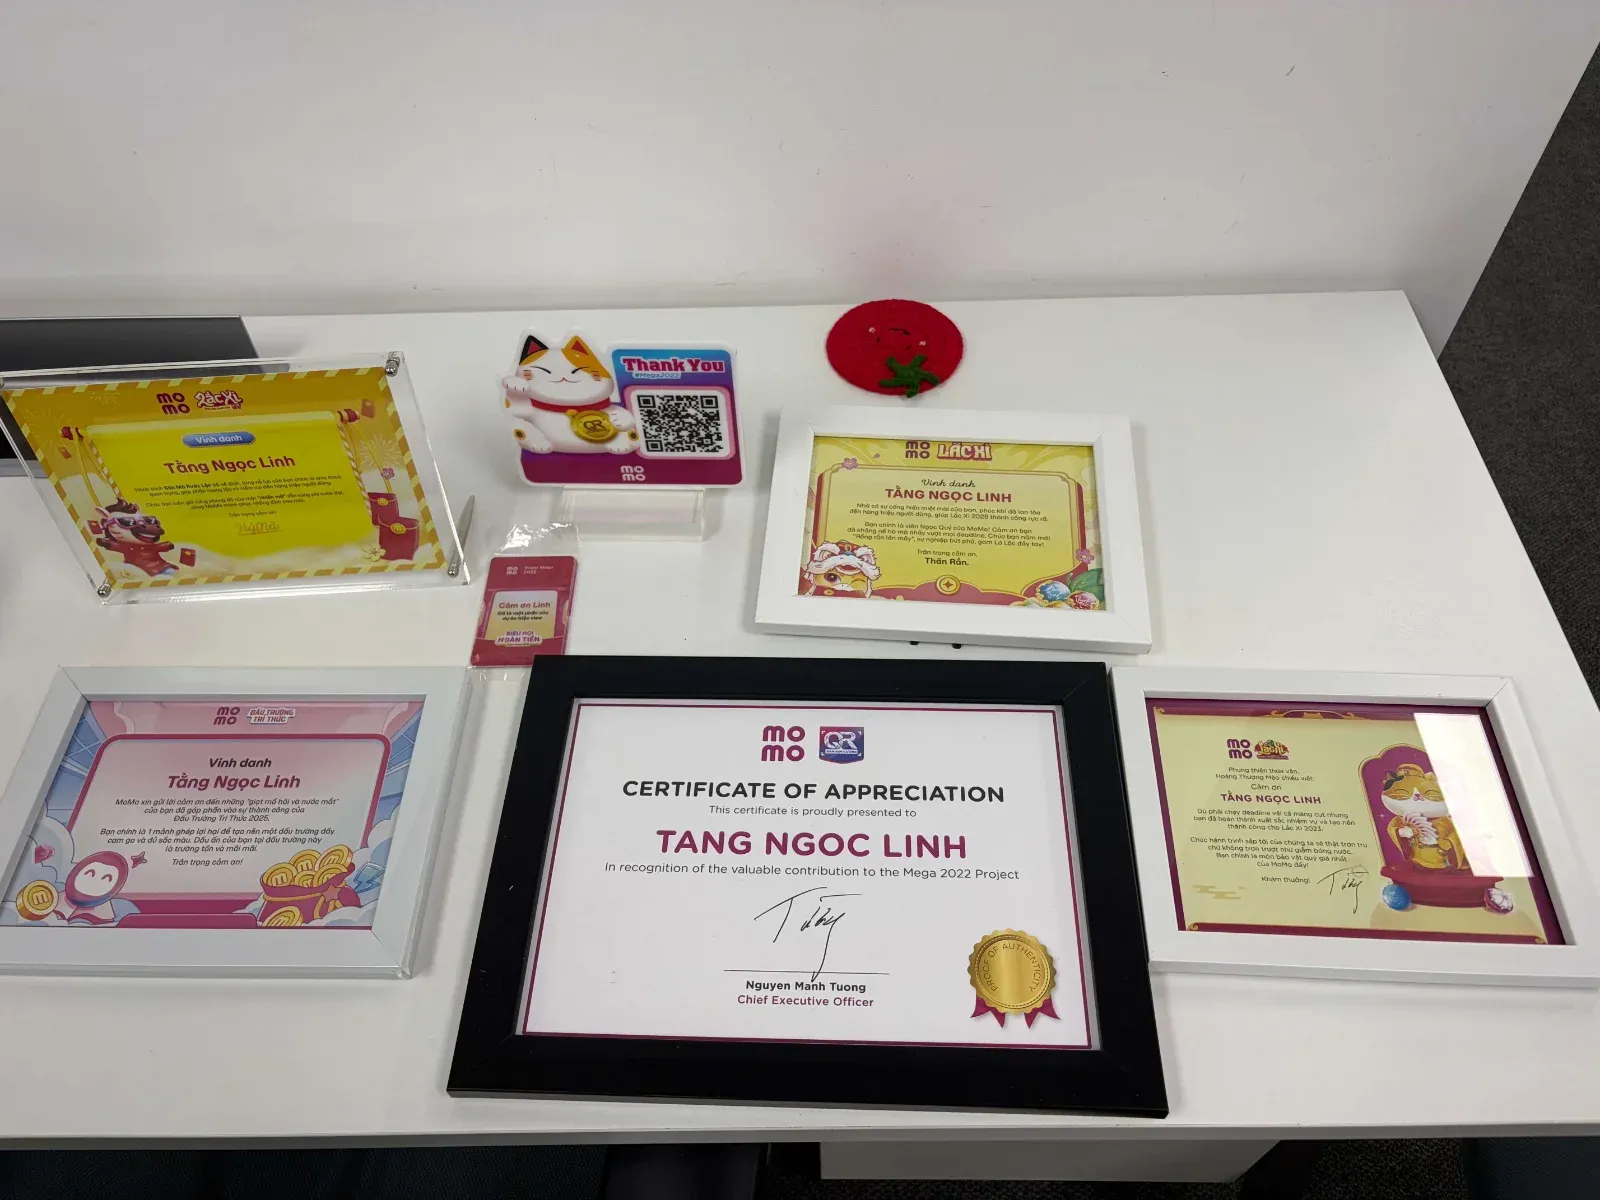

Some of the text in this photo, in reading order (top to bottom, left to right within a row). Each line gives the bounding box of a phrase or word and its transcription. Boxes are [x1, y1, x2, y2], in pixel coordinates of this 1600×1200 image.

[622, 358, 724, 372] Thank You
[194, 434, 242, 444] Vinh danh
[211, 458, 256, 473] Ngọc
[258, 456, 296, 469] Linh
[921, 478, 976, 488] Vinh danh
[928, 490, 973, 503] NGỌC
[976, 492, 1011, 503] LINH
[824, 731, 858, 750] QR
[209, 758, 272, 768] Vinh danh
[214, 775, 260, 791] Ngọc
[264, 775, 300, 788] Linh
[623, 780, 1004, 802] CERTIFICATE OF APPRECIATION
[115, 798, 140, 806] MoMo
[1256, 795, 1290, 805] NGỌC
[1293, 796, 1321, 804] LINH
[709, 805, 917, 818] This certificate is proudly presented to
[656, 830, 966, 859] TANG NGOC LINH
[605, 862, 1019, 881] In recognition of the valuable contribution to the Mega 2022 Project
[988, 946, 999, 958] OF
[1002, 943, 1041, 992] AUTHENTICITY
[982, 959, 998, 992] PROOF
[746, 980, 866, 994] Nguyen Manh Tuong
[737, 995, 874, 1007] Chief Executive Officer
